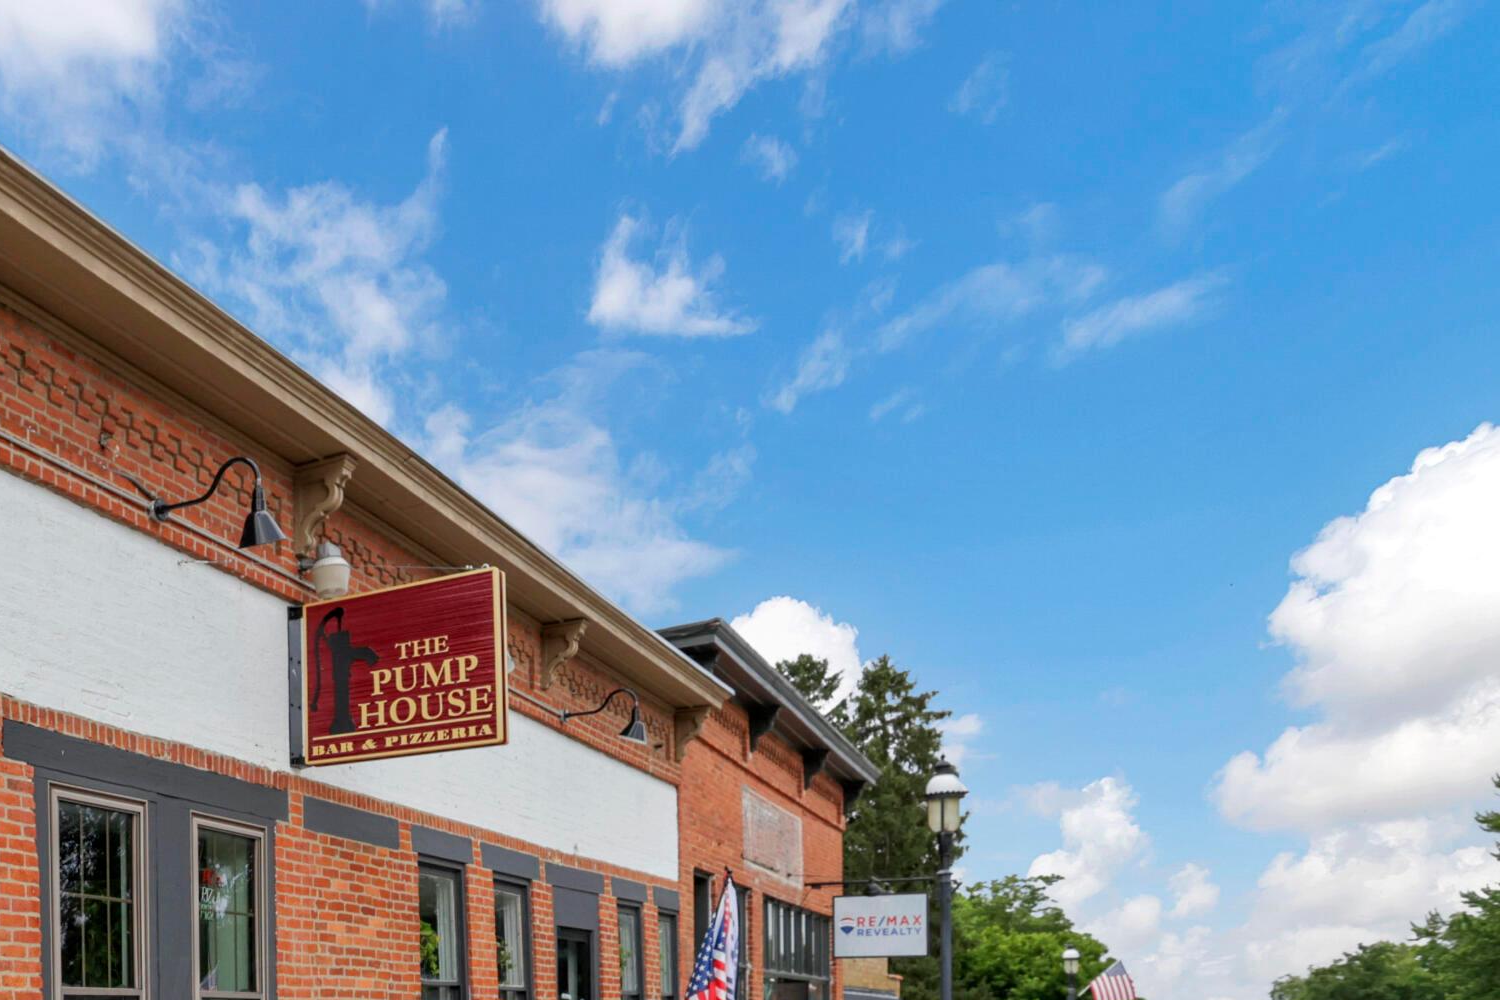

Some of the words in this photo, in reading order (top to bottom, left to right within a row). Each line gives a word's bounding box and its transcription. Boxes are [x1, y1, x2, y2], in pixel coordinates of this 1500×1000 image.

[395, 635, 449, 660] THE
[370, 654, 479, 696] PUMP
[358, 684, 493, 729] HOUSE
[312, 741, 354, 757] BAR
[361, 738, 377, 750] &
[385, 723, 493, 748] PIZZERIA
[856, 914, 922, 927] RE/MAX
[856, 927, 922, 937] REVEALTY
